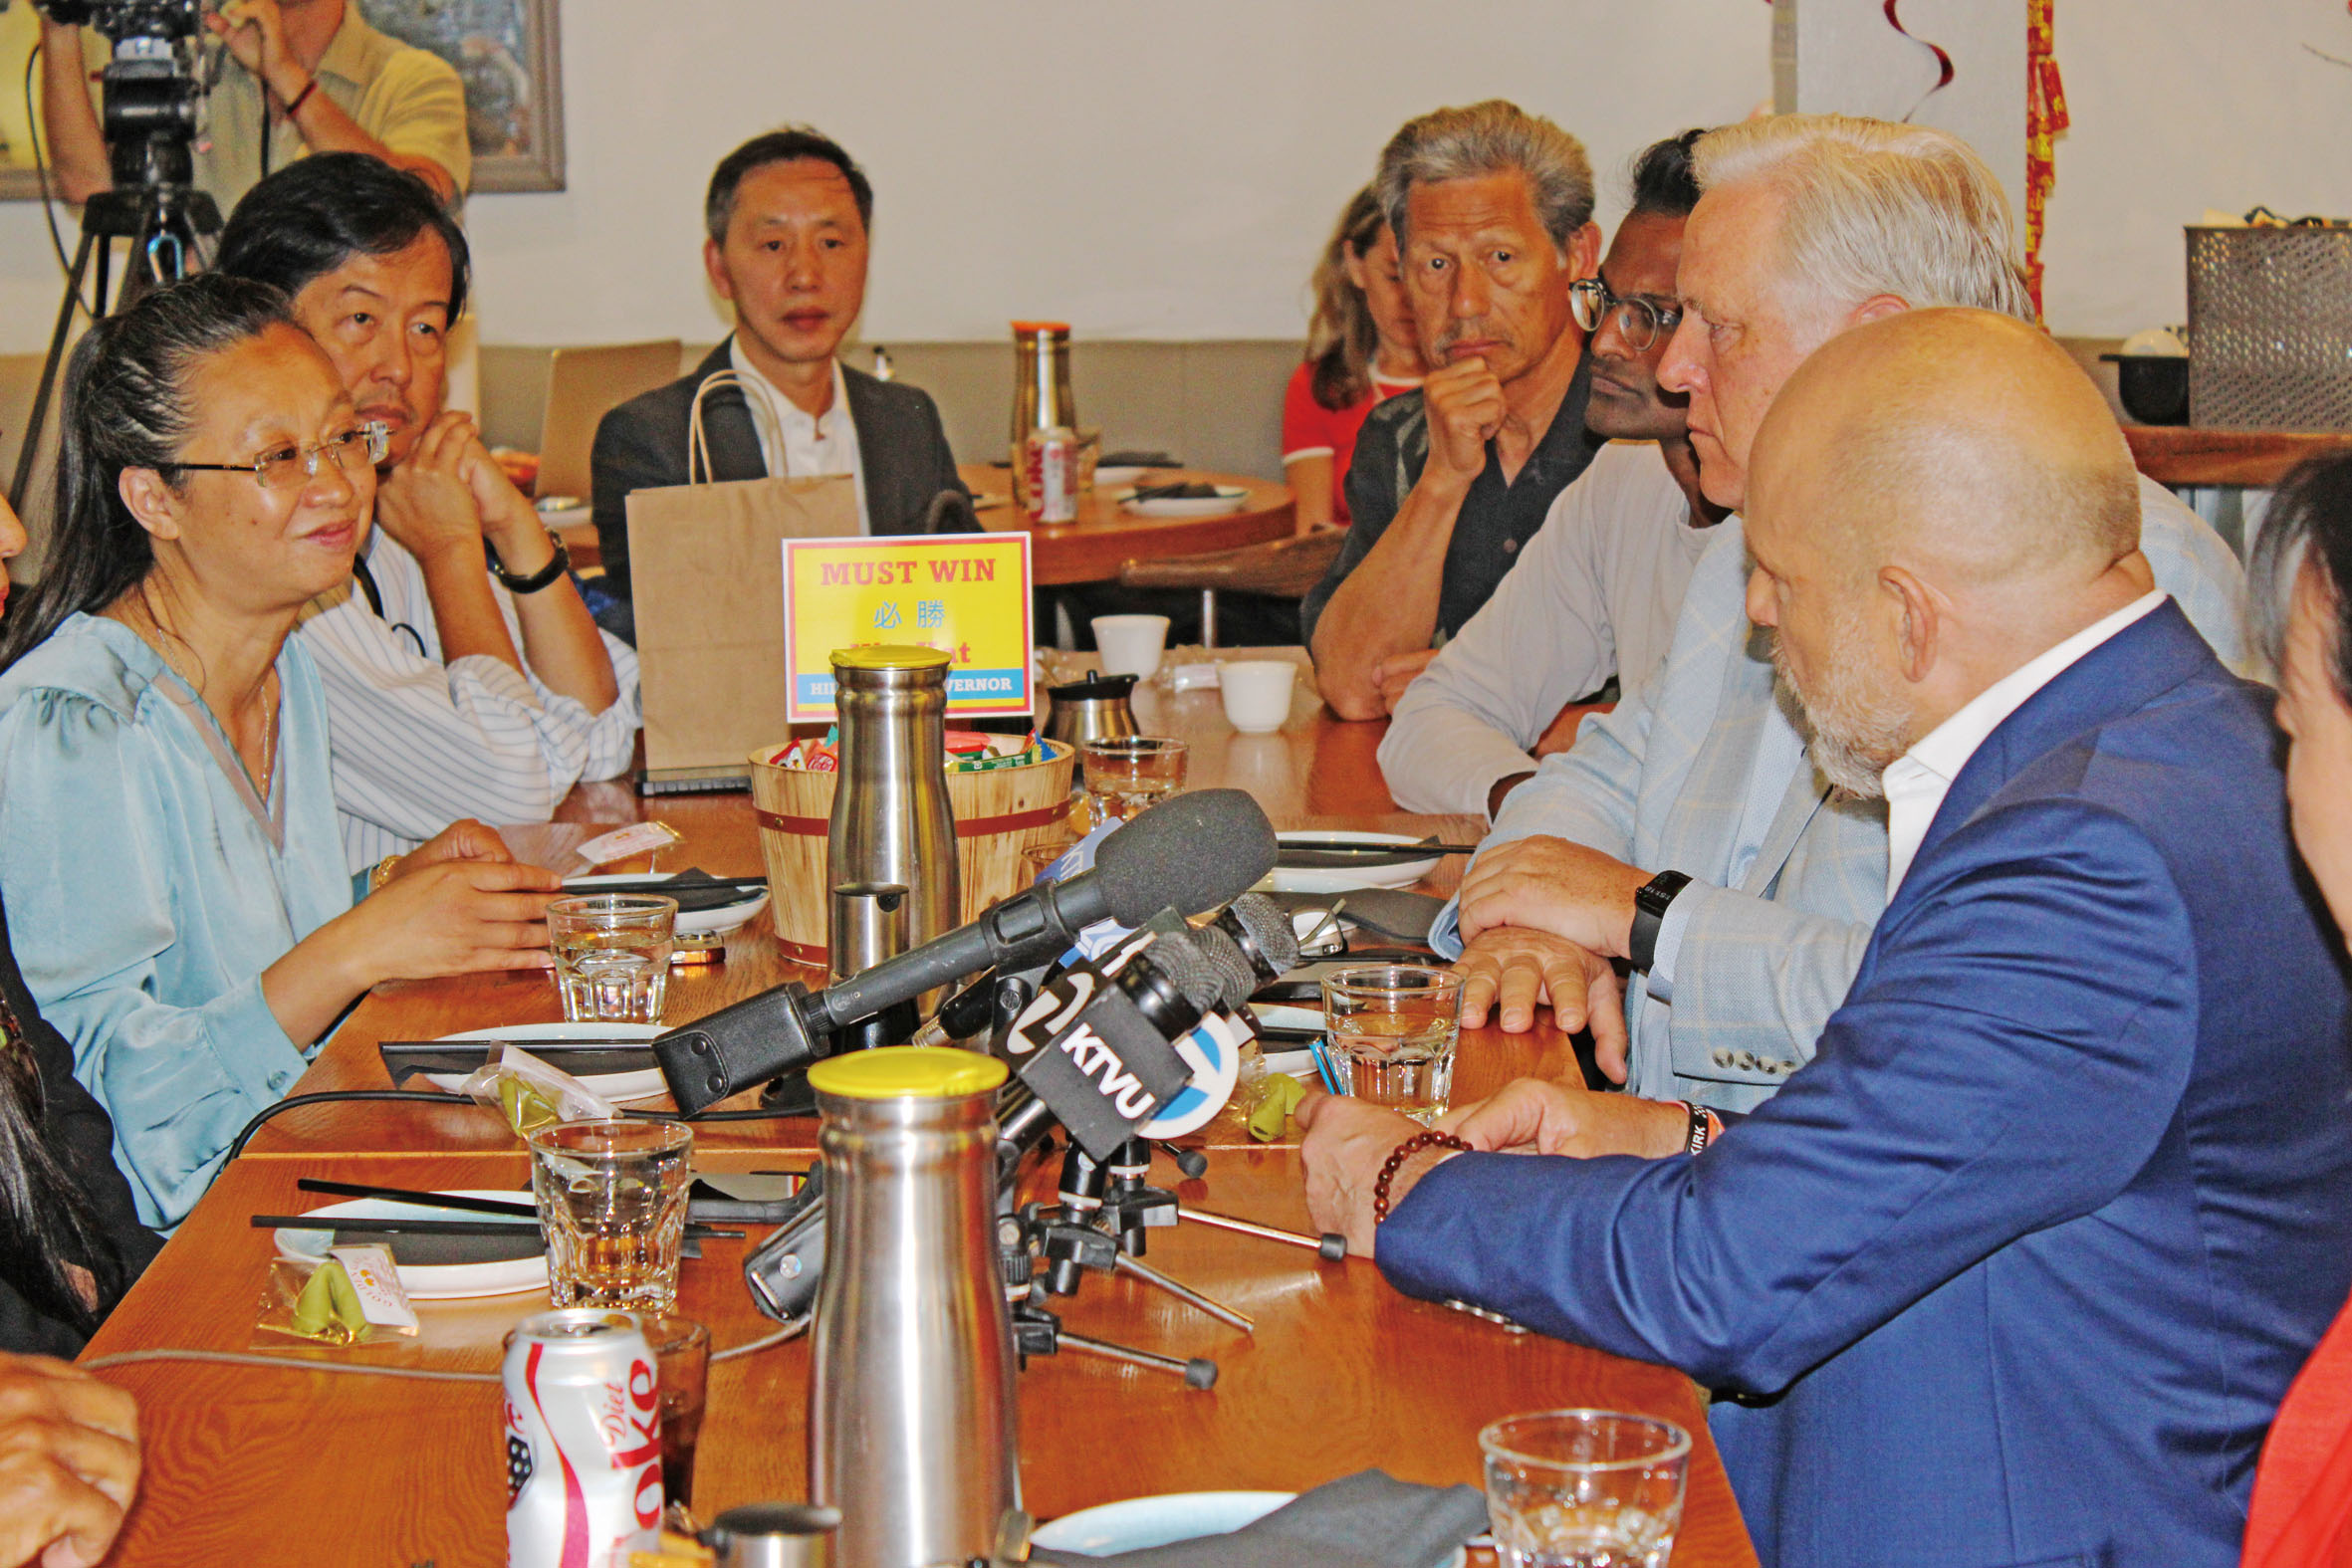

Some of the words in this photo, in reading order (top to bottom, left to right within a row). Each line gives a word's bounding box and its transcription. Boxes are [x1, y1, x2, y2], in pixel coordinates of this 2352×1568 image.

[821, 561, 917, 585] MUST
[928, 559, 996, 582] WIN
[873, 599, 946, 629] 必勝
[943, 677, 1012, 692] VERNOR
[1060, 1022, 1156, 1119] KTVU
[1690, 1125, 1706, 1155] KIRK
[599, 1381, 627, 1448] Diet
[612, 1359, 664, 1539] oke
